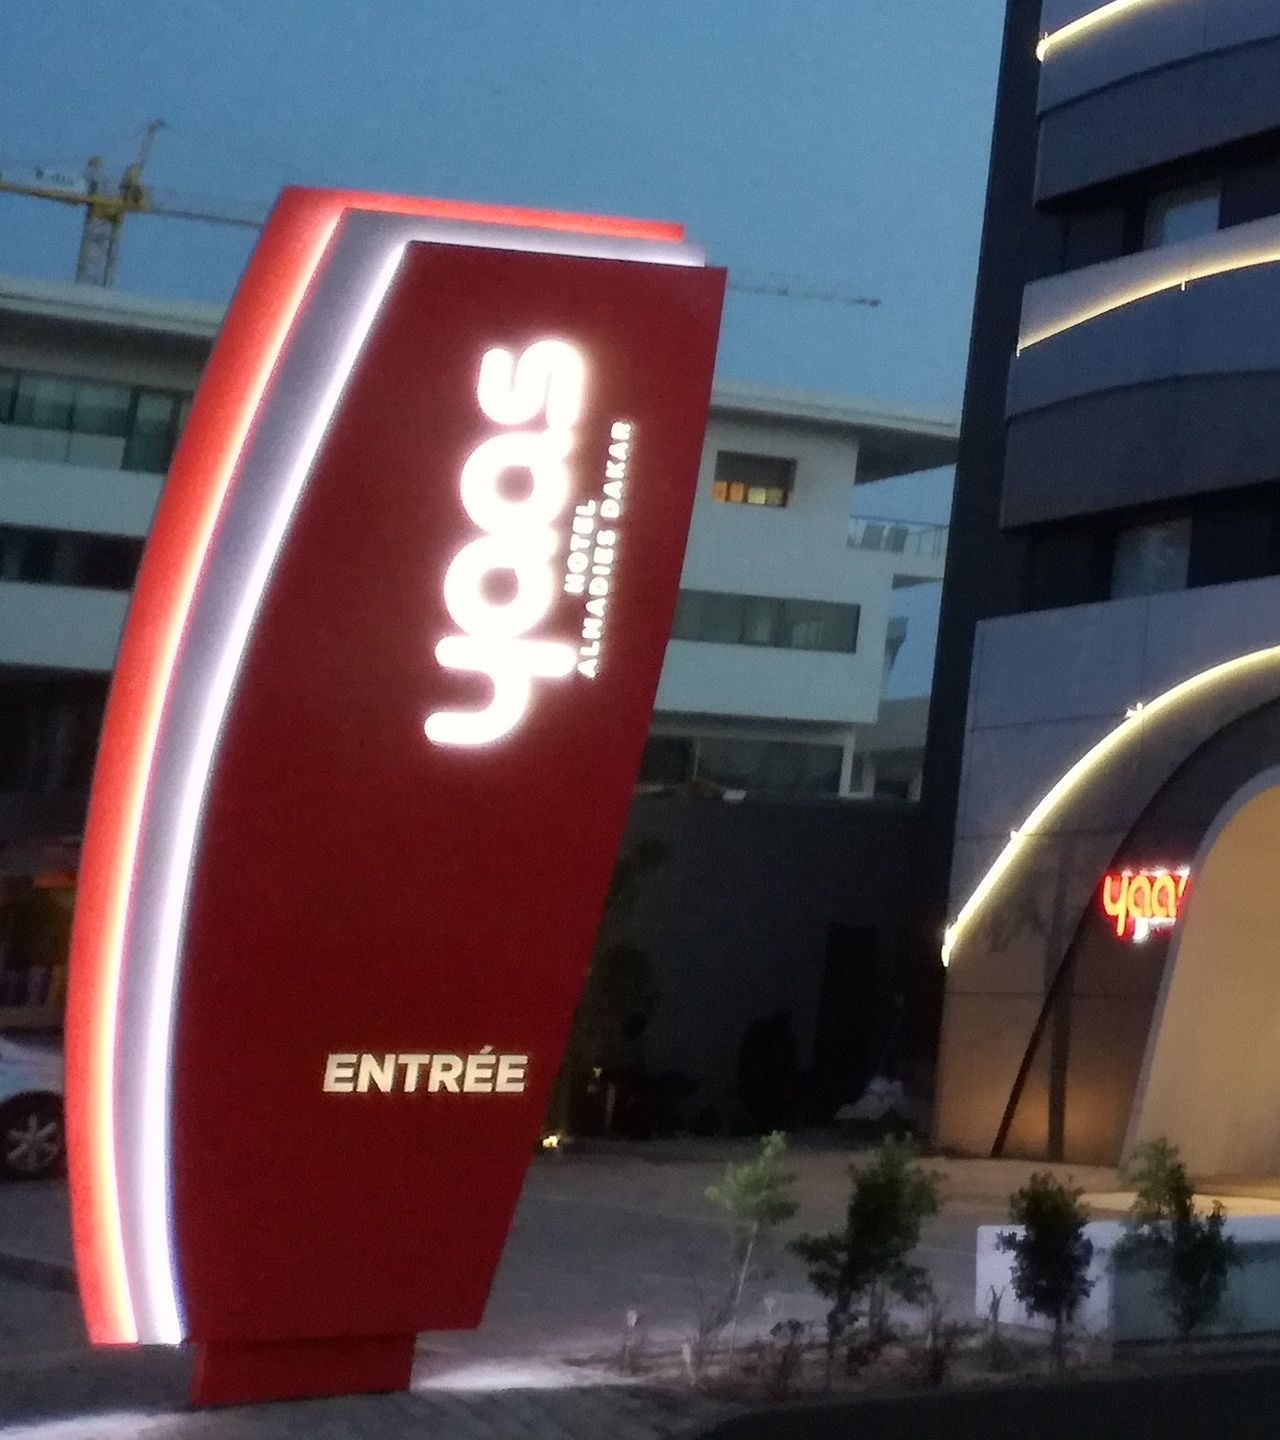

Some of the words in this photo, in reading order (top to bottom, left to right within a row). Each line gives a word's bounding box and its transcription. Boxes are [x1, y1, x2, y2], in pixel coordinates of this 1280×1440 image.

[425, 340, 586, 747] yaas
[563, 499, 596, 594] HOTEL
[577, 529, 616, 680] ALMADIES
[600, 421, 631, 520] DAKAR
[1103, 869, 1190, 937] yaa
[323, 1045, 529, 1093] ENTRÉE
